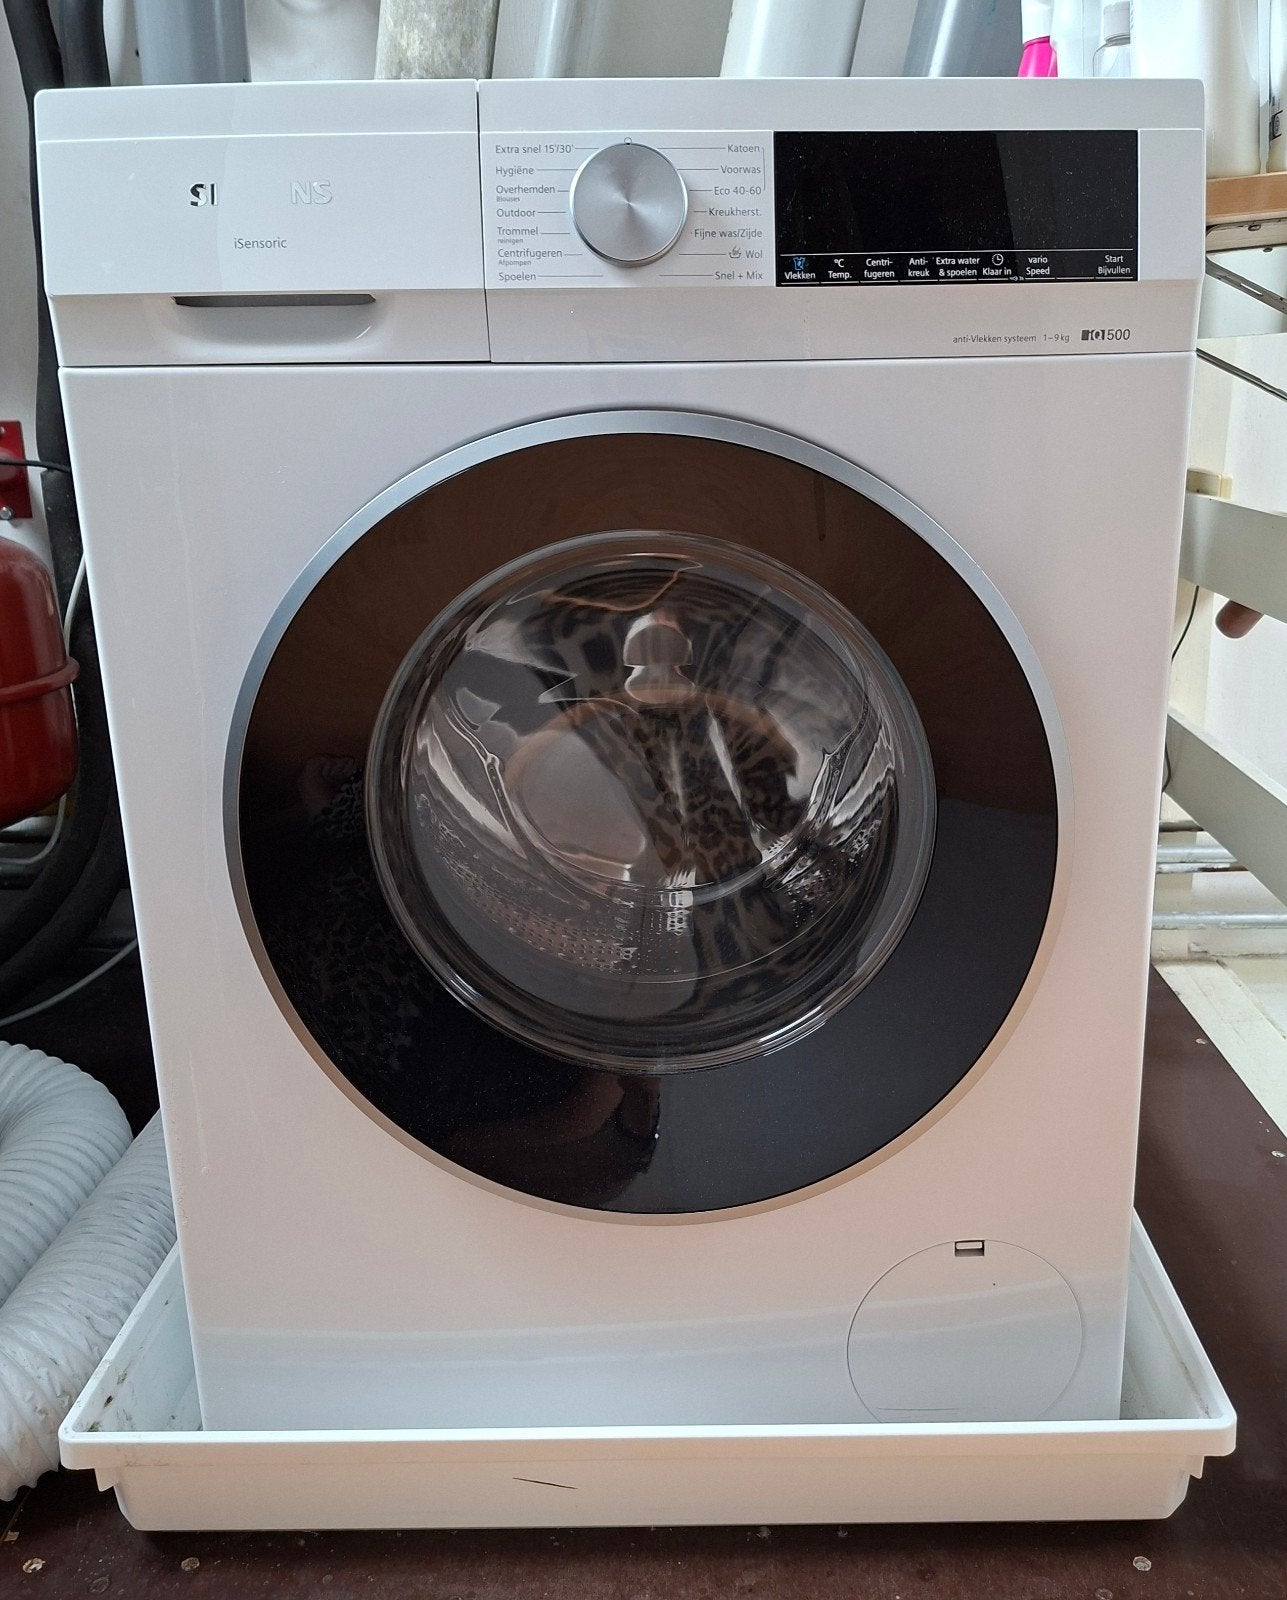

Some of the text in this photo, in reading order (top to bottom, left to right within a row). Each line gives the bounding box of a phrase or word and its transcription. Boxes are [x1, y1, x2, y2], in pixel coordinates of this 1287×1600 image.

[495, 145, 520, 154] Extra
[522, 144, 542, 154] snel
[727, 144, 760, 153] Katoen
[495, 165, 534, 177] Hygiëne
[720, 165, 761, 174] Voorwas
[496, 185, 555, 194] Overhemden
[714, 186, 761, 195] Eco 40-60
[496, 208, 536, 218] Outdoor
[709, 207, 762, 217] Kreukherst.
[497, 226, 539, 236] Trommel
[694, 228, 763, 240] Fijne was/Zijde
[234, 237, 288, 249] iSensoric
[497, 249, 563, 260] Centrifugeren
[745, 250, 763, 259] Wol
[1028, 255, 1048, 264] vario
[1104, 254, 1124, 263] Start
[865, 258, 894, 267] Centri-
[909, 257, 929, 266] Anti-
[935, 257, 980, 265] Extra water
[784, 271, 816, 280] Vlekken
[828, 271, 853, 280] Temp.
[864, 270, 895, 280] fugeren
[908, 268, 930, 277] kreuk
[938, 267, 978, 278] & spoelen
[982, 266, 1012, 276] Klaar in
[1026, 266, 1050, 277] Speed
[1097, 265, 1131, 276] Bijvullen
[498, 272, 537, 283] Spoelen
[715, 271, 735, 281] Snel
[746, 271, 763, 280] Mix
[952, 334, 1037, 344] anti-Vlekken systeem
